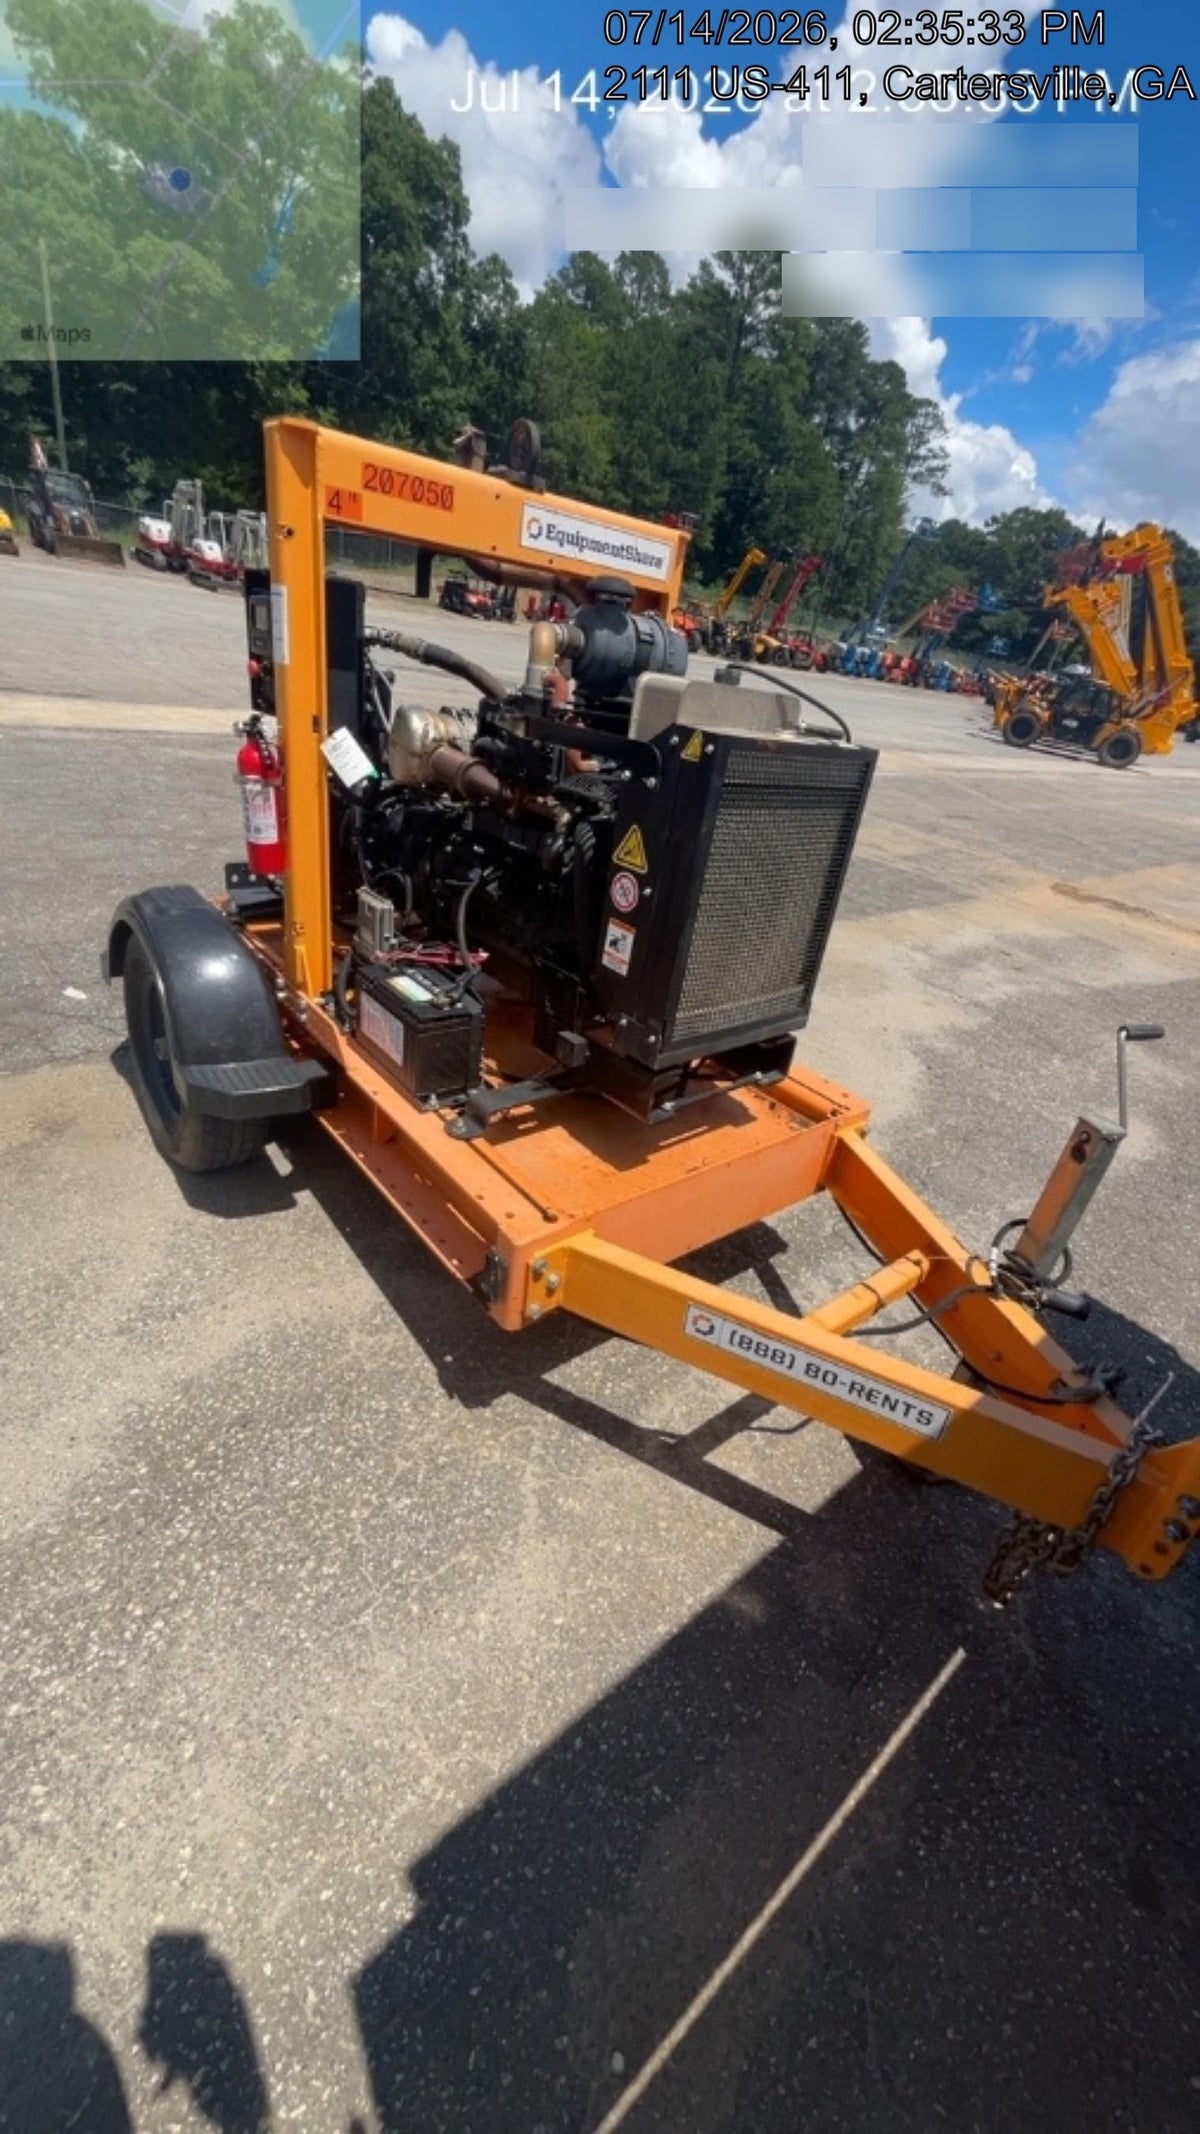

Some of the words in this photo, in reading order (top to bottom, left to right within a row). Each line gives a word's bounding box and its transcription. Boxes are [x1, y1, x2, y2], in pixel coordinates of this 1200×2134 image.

[364, 462, 455, 511] 207050
[728, 1328, 797, 1371] (888)
[803, 1361, 934, 1428] 80-RENTS
